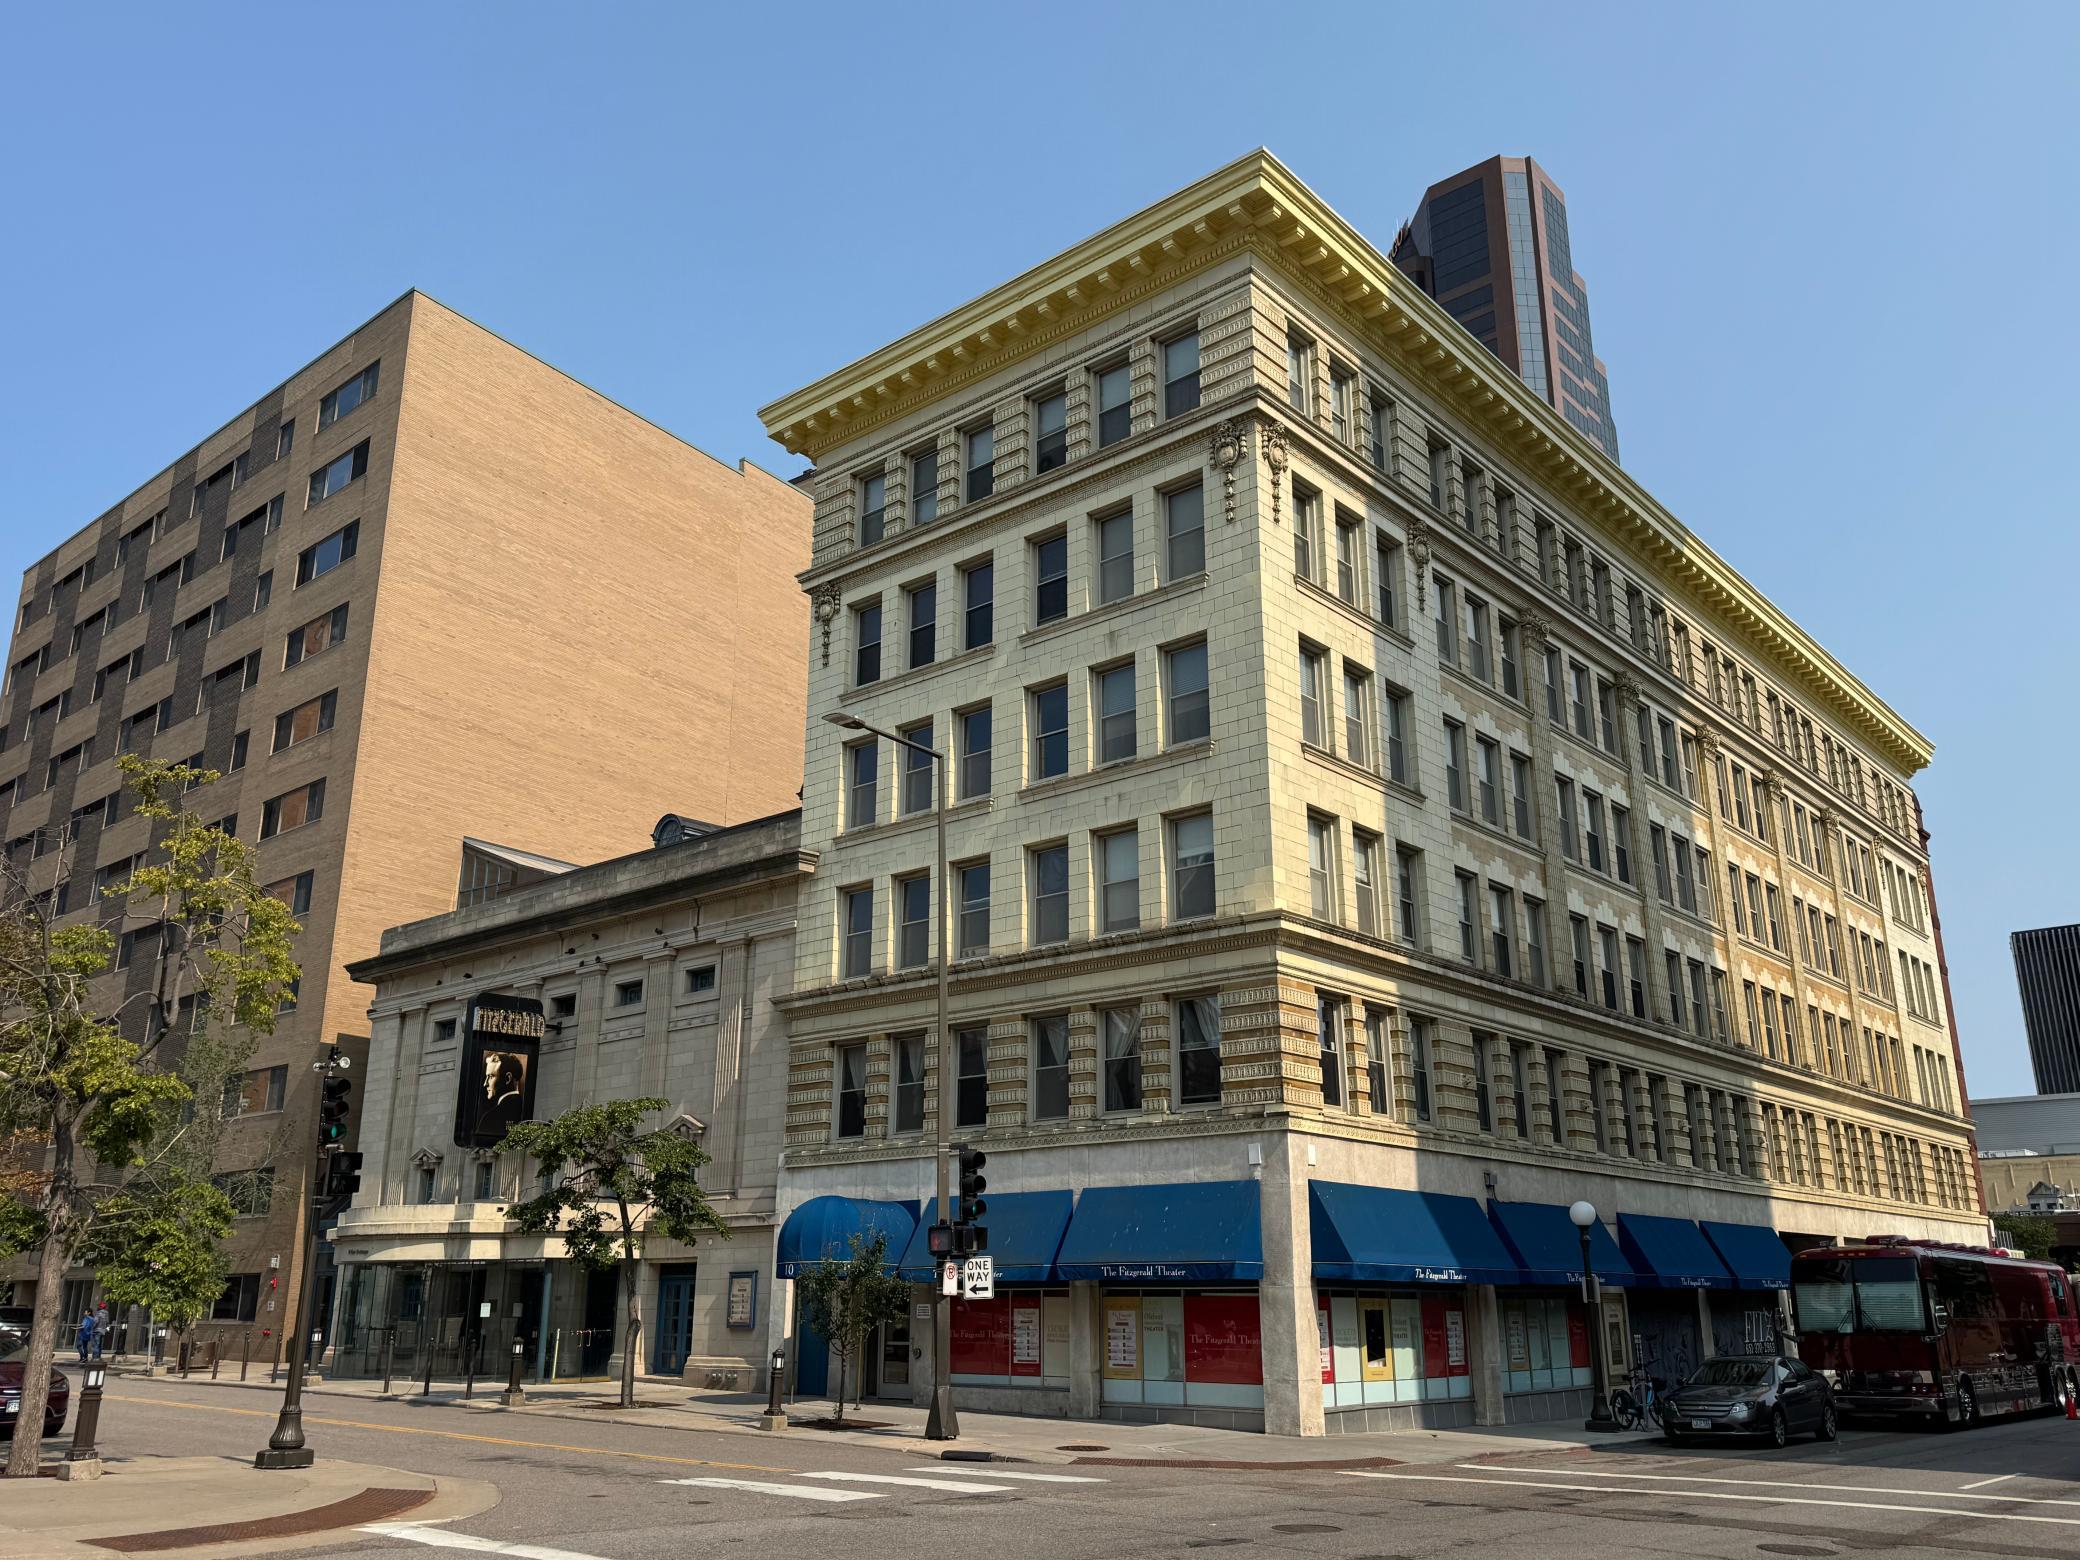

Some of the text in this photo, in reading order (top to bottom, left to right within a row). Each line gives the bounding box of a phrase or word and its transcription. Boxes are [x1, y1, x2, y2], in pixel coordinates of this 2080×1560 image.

[475, 1007, 545, 1037] FITZGERALD
[785, 1264, 794, 1276] 10
[967, 1261, 989, 1271] ONE
[1101, 1265, 1186, 1278] The Fitzgerald Theater
[967, 1272, 990, 1282] WAY
[1415, 1268, 1424, 1279] The
[1744, 1309, 1774, 1342] FITZ
